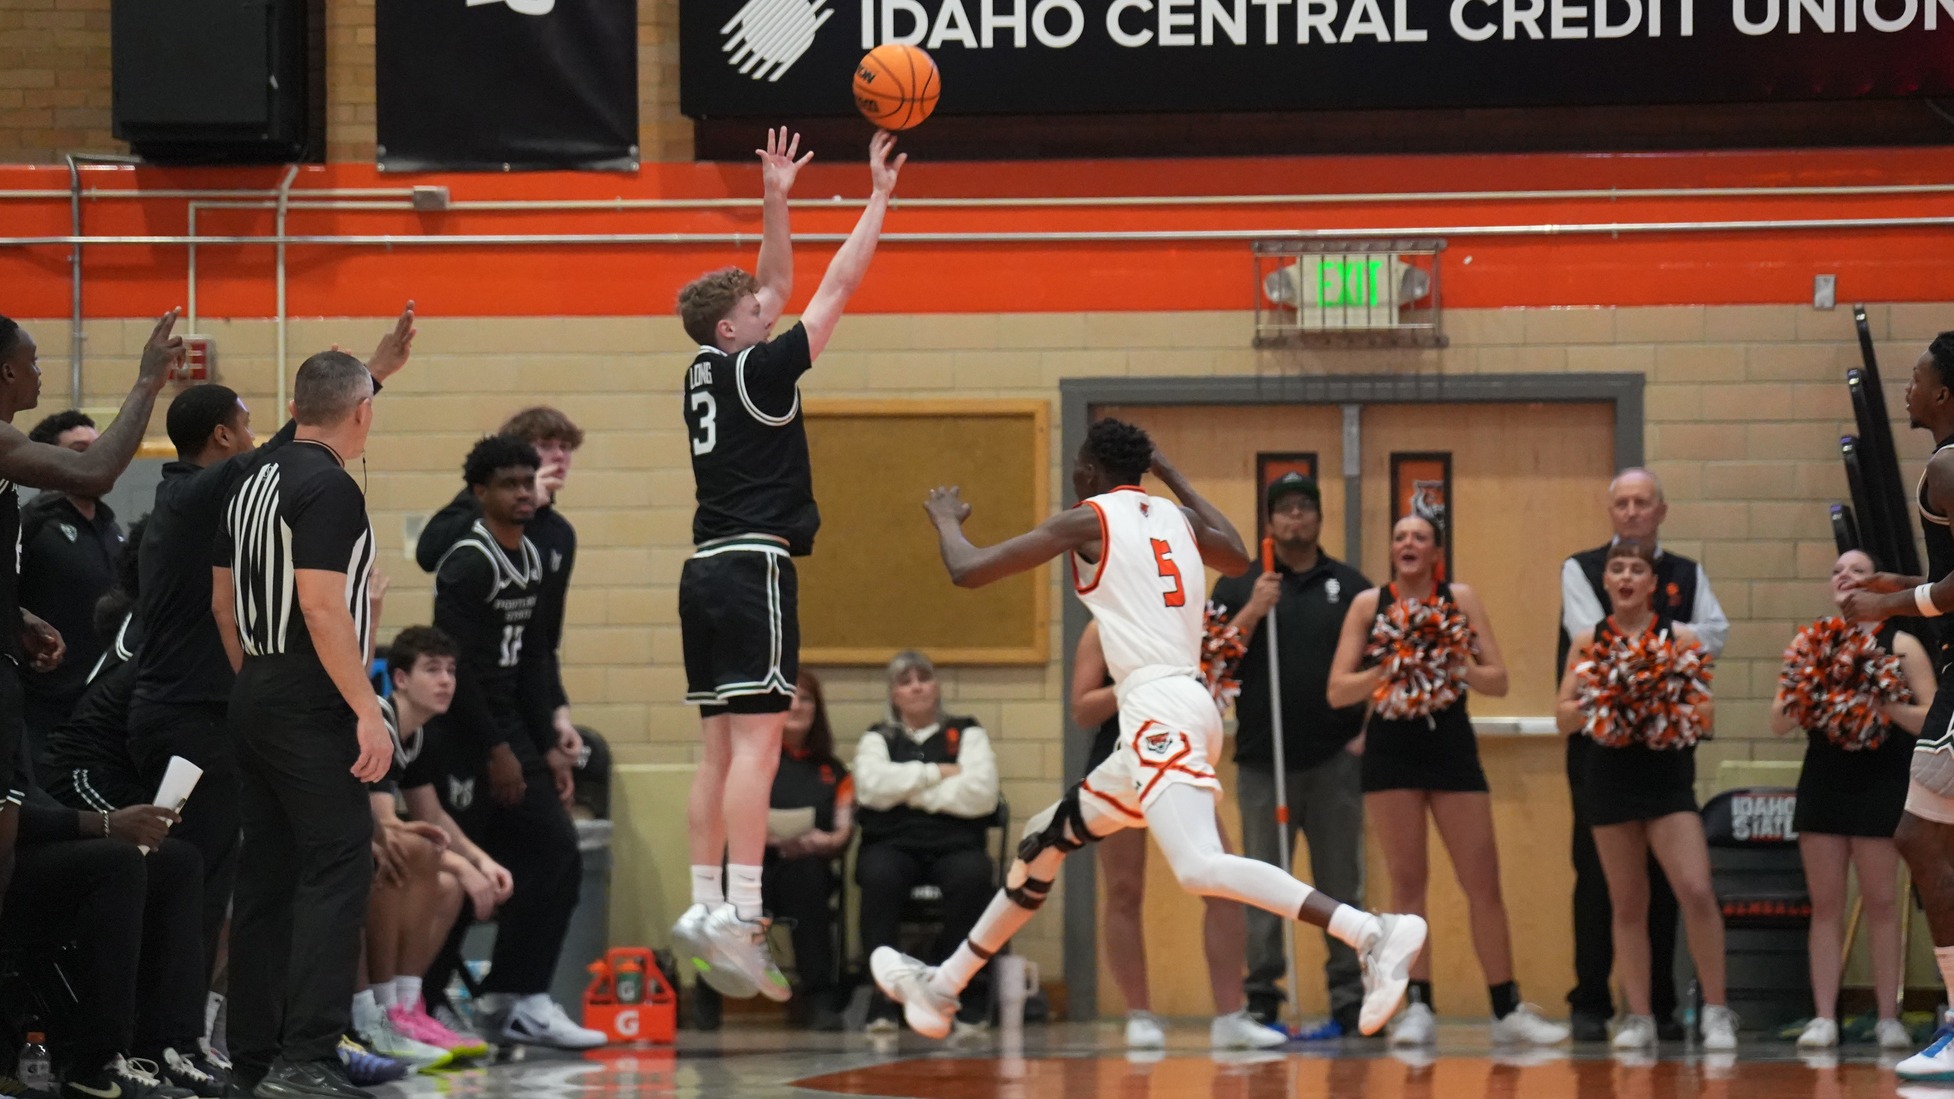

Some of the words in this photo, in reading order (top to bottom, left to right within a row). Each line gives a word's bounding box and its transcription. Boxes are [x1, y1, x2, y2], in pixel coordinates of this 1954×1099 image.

[861, 0, 1085, 49] IDAHO
[1106, 0, 1427, 47] CENTRAL
[1317, 260, 1382, 308] EXIT
[689, 361, 713, 390] LONG
[691, 391, 717, 455] 3
[1150, 538, 1185, 607] 5
[1731, 797, 1797, 815] IDAHO
[617, 980, 635, 1002] G
[615, 1010, 639, 1037] G
